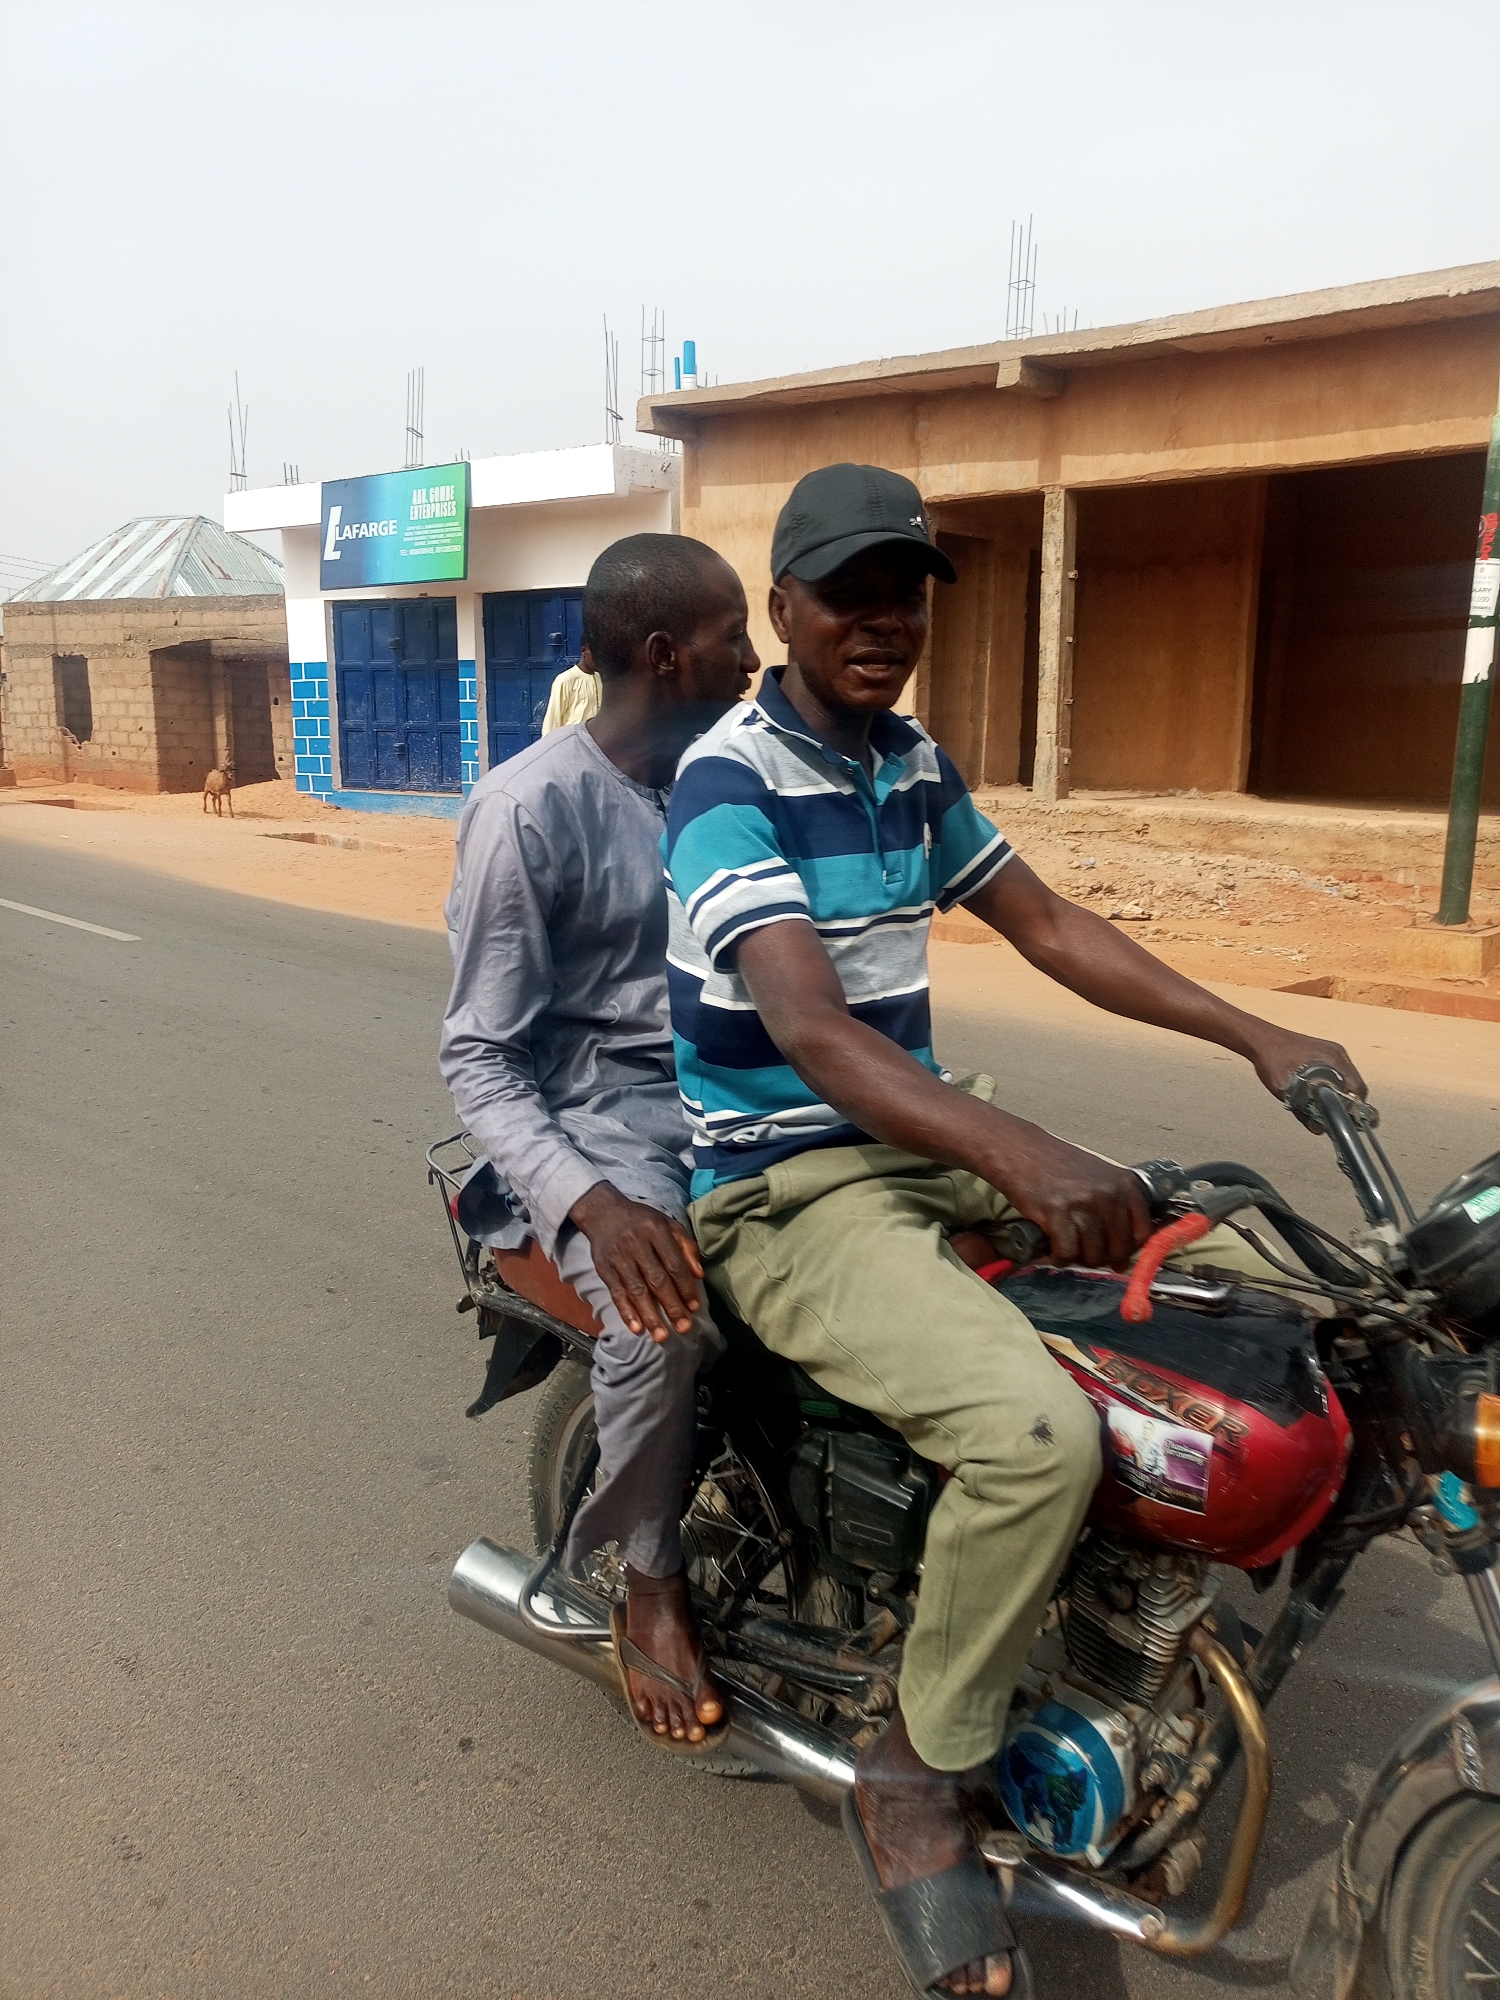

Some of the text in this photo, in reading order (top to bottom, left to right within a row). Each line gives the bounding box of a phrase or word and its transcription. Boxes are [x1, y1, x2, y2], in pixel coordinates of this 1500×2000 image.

[430, 485, 455, 503] GOMBE
[410, 501, 456, 520] ENTERPRISES
[335, 519, 398, 541] LAFARGE
[1094, 1355, 1251, 1446] BOXER
[539, 1392, 570, 1458] SECURA
